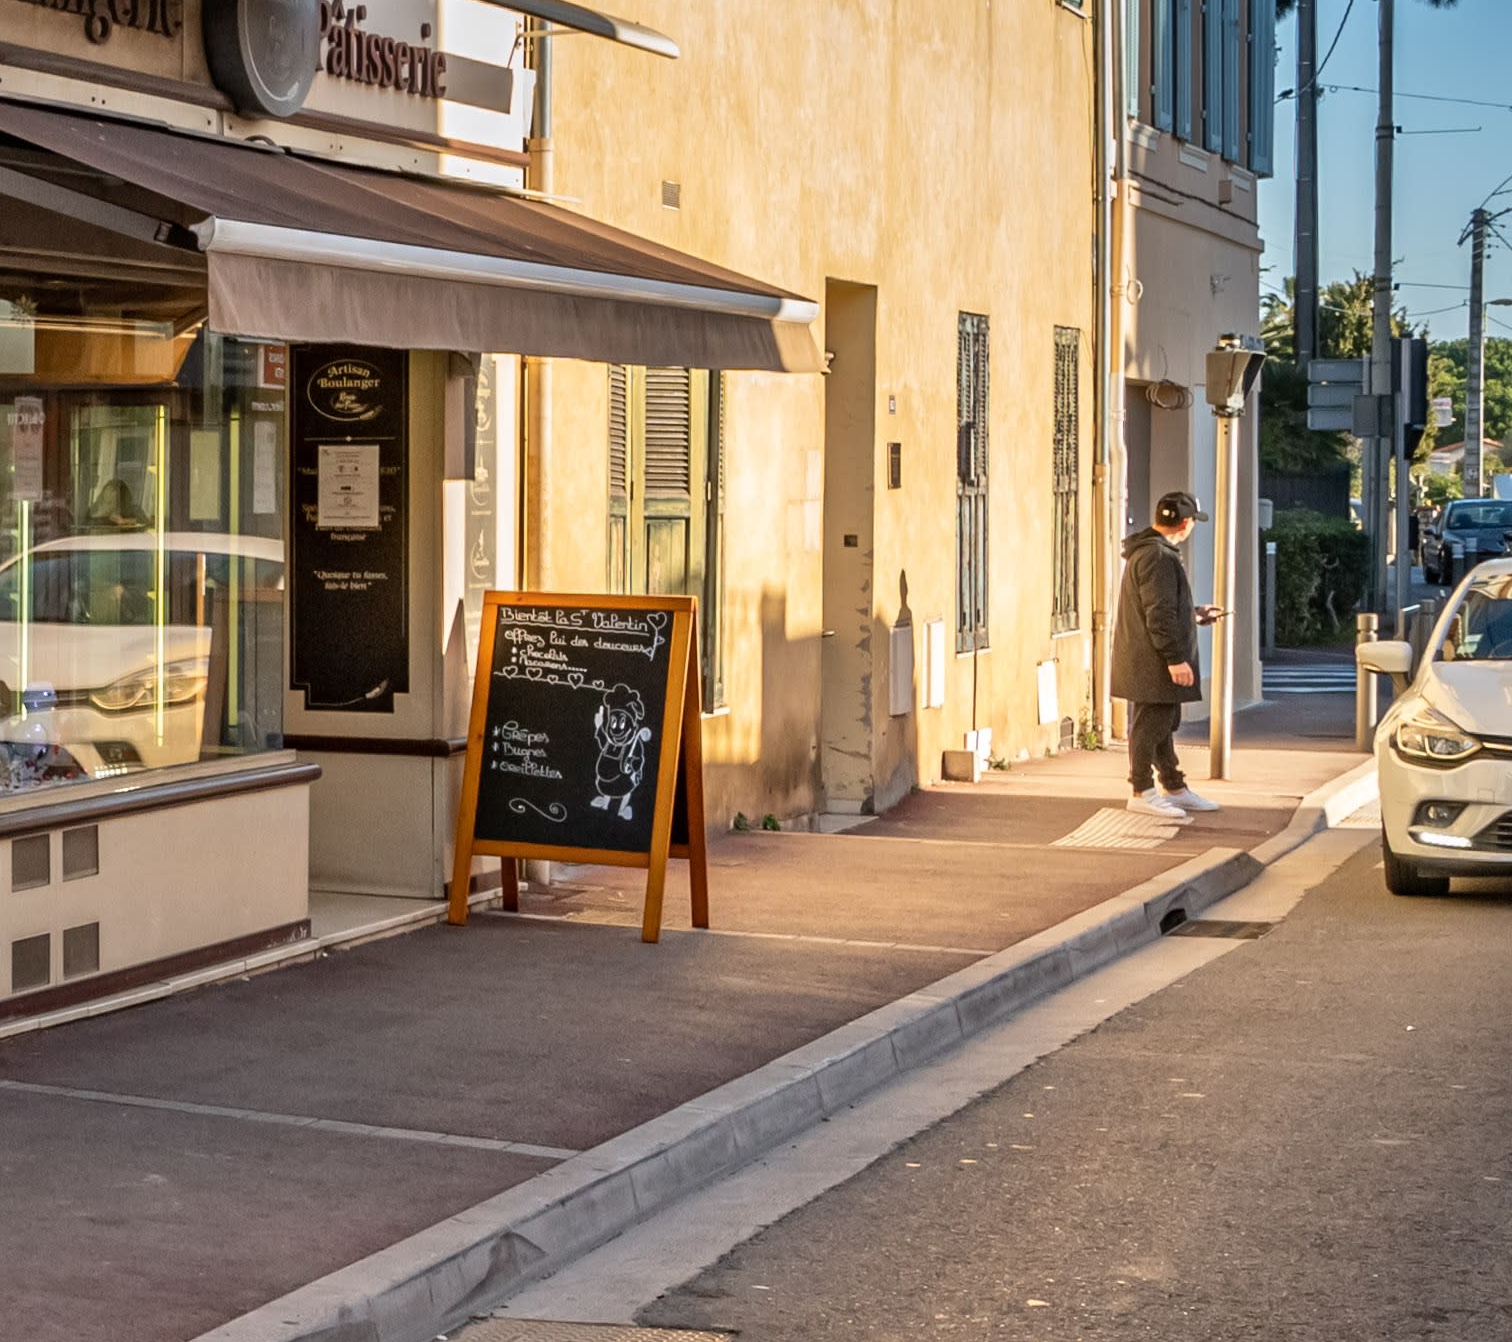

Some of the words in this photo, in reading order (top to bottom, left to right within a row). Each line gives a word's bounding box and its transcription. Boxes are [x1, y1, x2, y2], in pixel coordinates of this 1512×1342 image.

[328, 363, 370, 378] Artisan
[317, 376, 381, 390] Boulanger
[501, 607, 553, 623] Bientôt
[592, 611, 648, 632] Valentin
[502, 741, 547, 762] Bugnes
